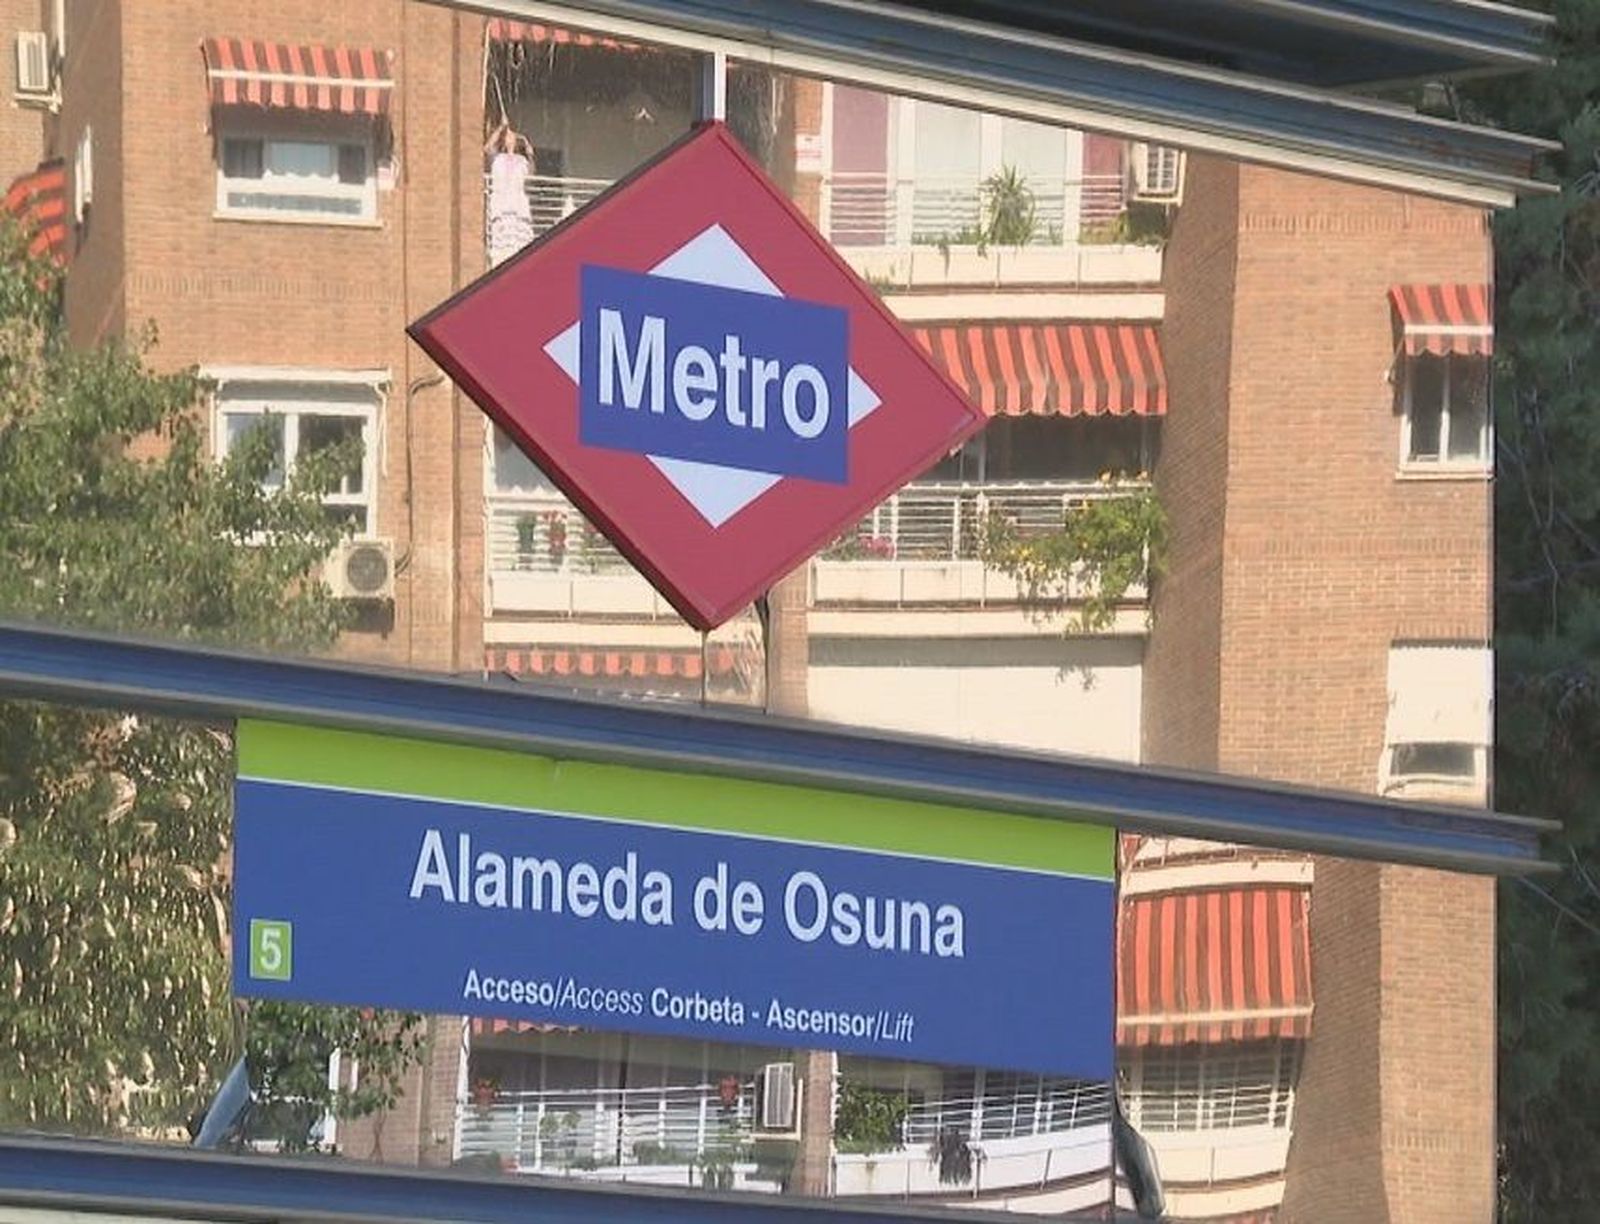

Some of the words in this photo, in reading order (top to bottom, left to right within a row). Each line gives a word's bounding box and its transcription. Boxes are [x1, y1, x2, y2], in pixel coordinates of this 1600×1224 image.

[598, 307, 830, 440] Metro
[409, 829, 674, 927] Alameda
[693, 862, 764, 936] de
[784, 870, 964, 958] Osuna
[258, 926, 283, 973] 5
[463, 969, 644, 1015] Acceso/Access
[651, 987, 744, 1026] Corbeta
[766, 999, 915, 1043] Ascensor/Lift
